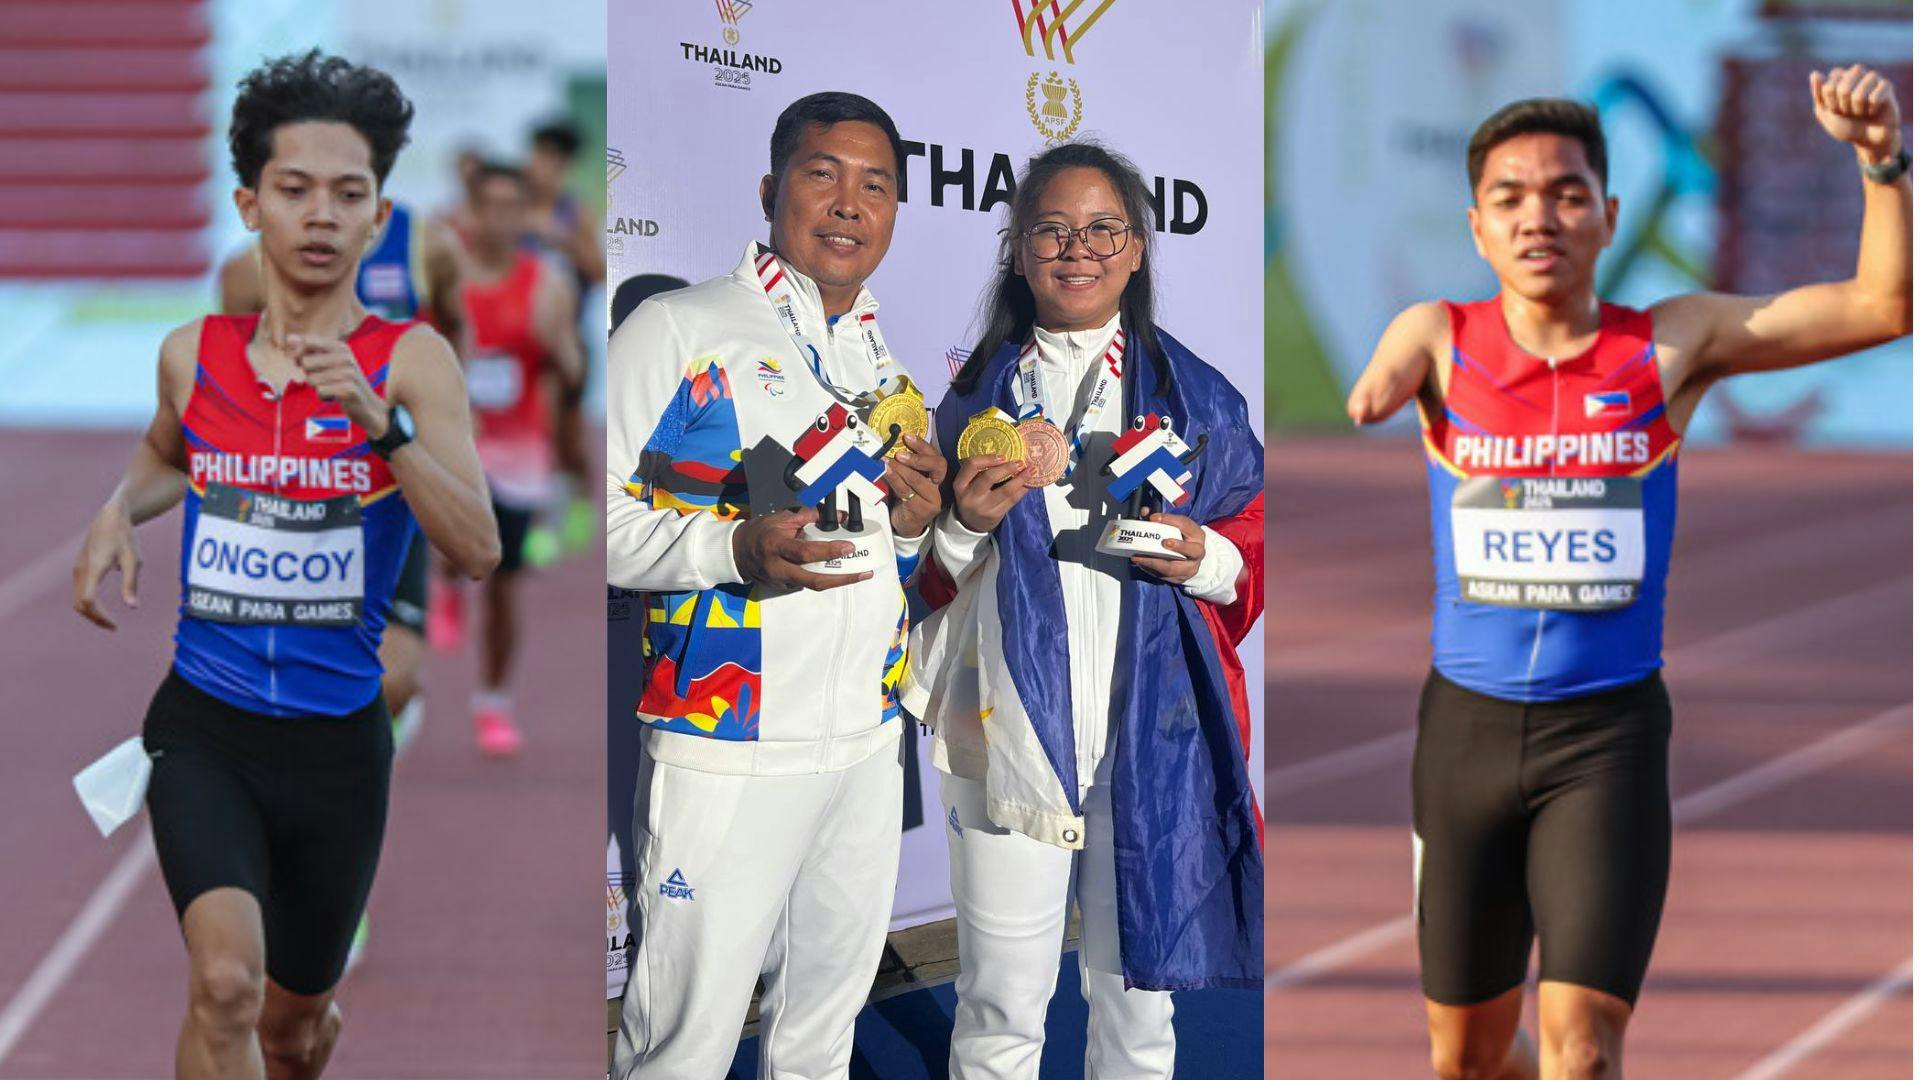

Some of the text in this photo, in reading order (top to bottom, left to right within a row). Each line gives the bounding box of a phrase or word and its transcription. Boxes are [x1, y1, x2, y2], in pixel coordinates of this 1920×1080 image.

[680, 42, 783, 75] THAILAND
[714, 67, 752, 85] 2025
[1044, 116, 1066, 126] APSF
[896, 139, 1208, 236] THAND
[607, 217, 660, 237] AND
[1453, 431, 1650, 468] PHILIPPINES
[190, 453, 372, 492] PHILIPPINES
[1523, 478, 1606, 498] THAILAND
[254, 496, 327, 521] THAILAND
[1119, 528, 1162, 541] THAILAND
[1482, 528, 1619, 564] REYES
[196, 537, 356, 584] ONGCOY
[1467, 580, 1635, 604] ASEAN PARA GAMES
[239, 602, 286, 620] PARA
[293, 603, 354, 621] GAMES
[659, 883, 696, 901] PEAK
